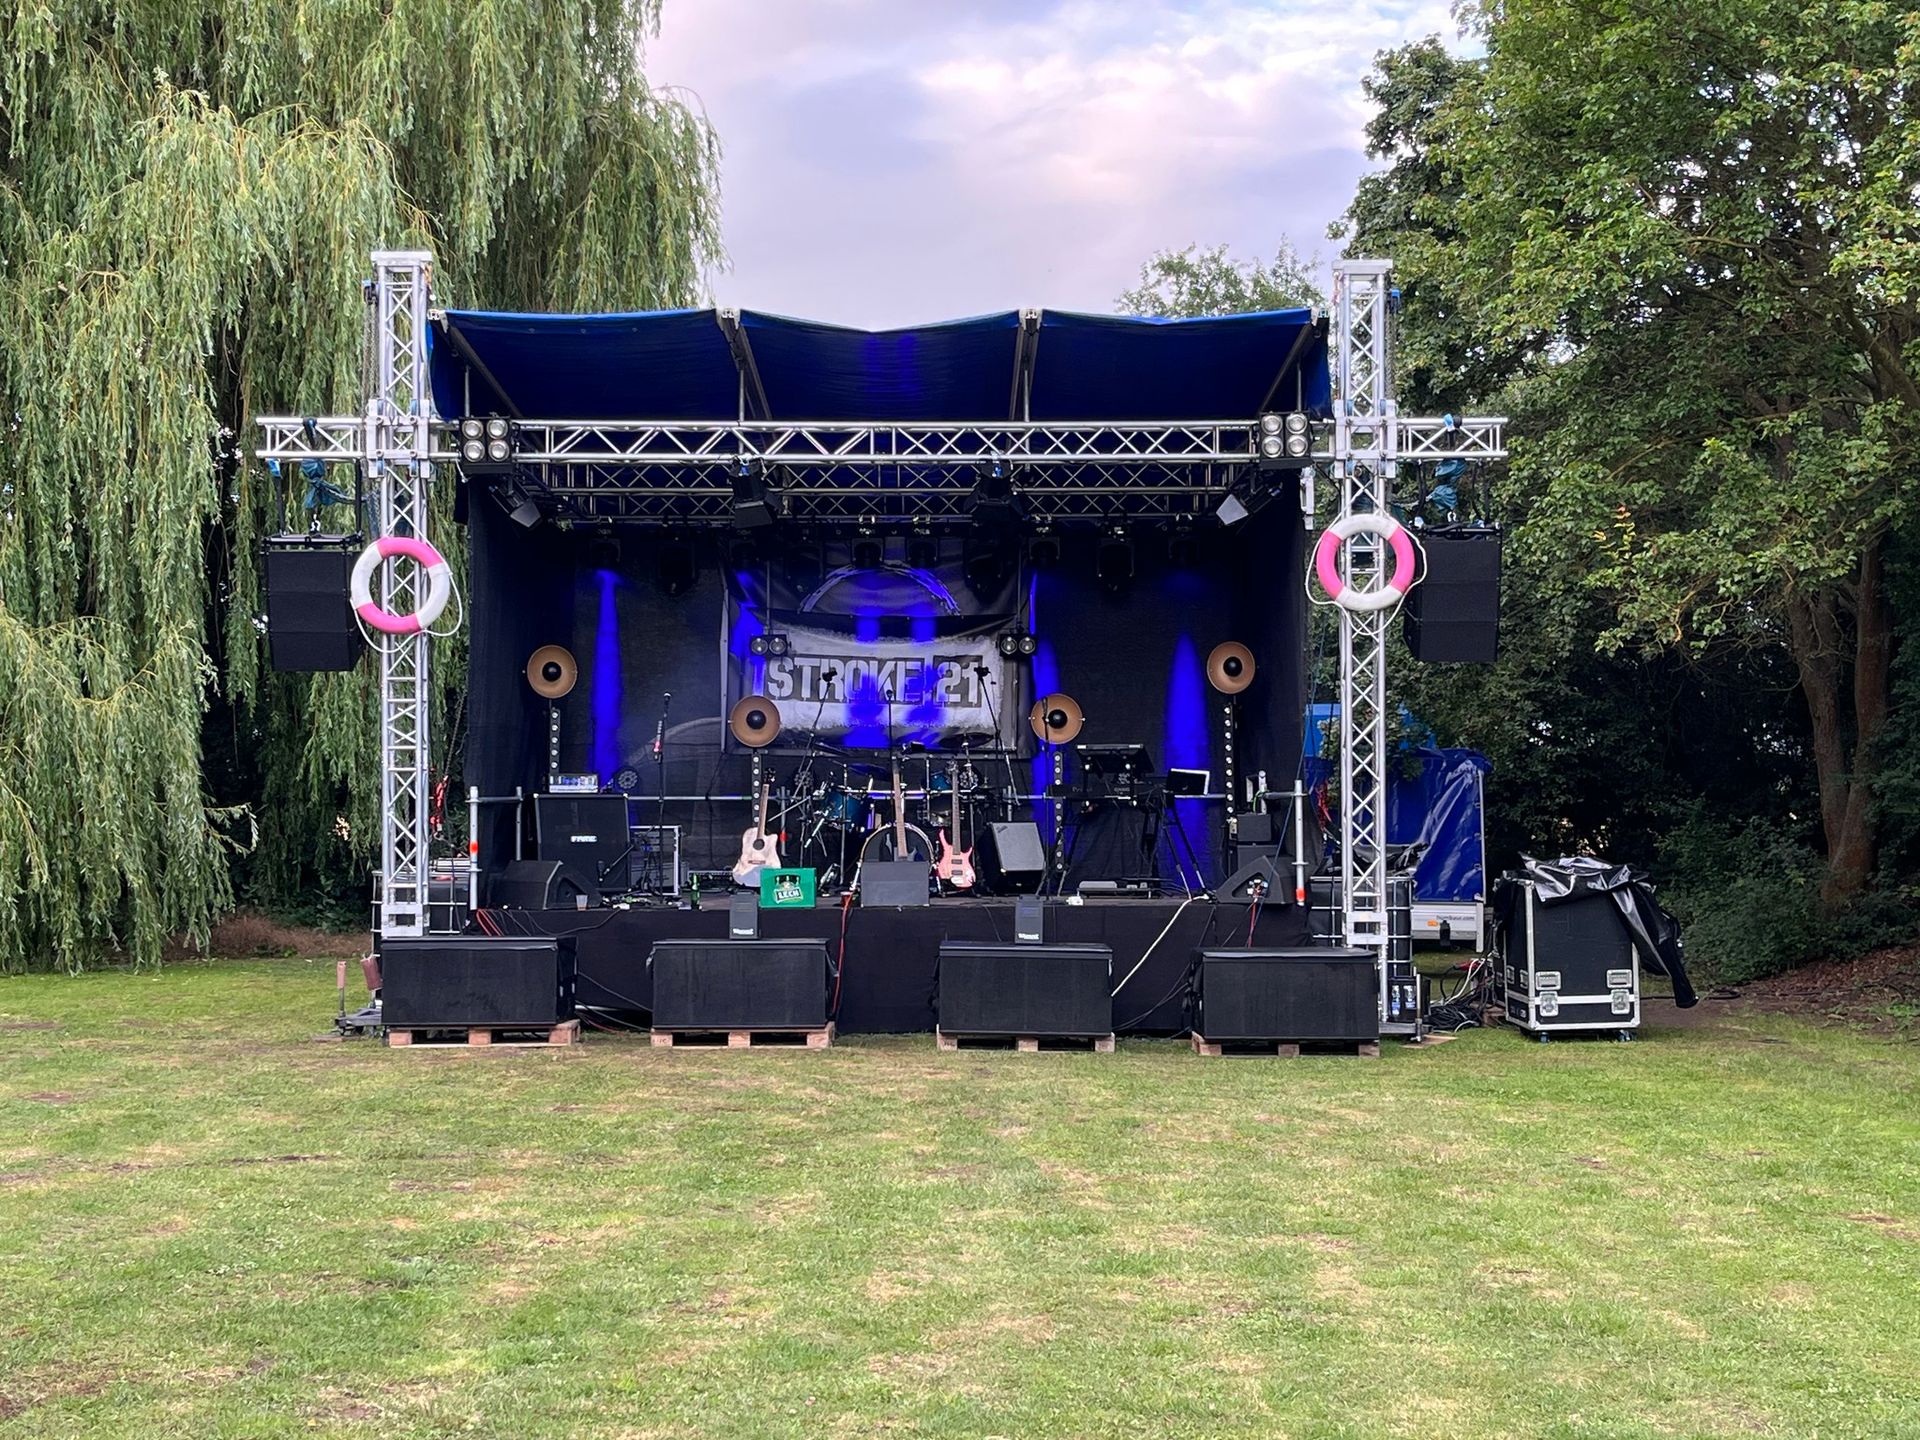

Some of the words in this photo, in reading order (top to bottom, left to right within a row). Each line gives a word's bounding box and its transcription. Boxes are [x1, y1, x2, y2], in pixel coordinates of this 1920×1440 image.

[767, 655, 923, 703] STROKE
[936, 660, 980, 706] 21
[777, 889, 800, 899] LECH
